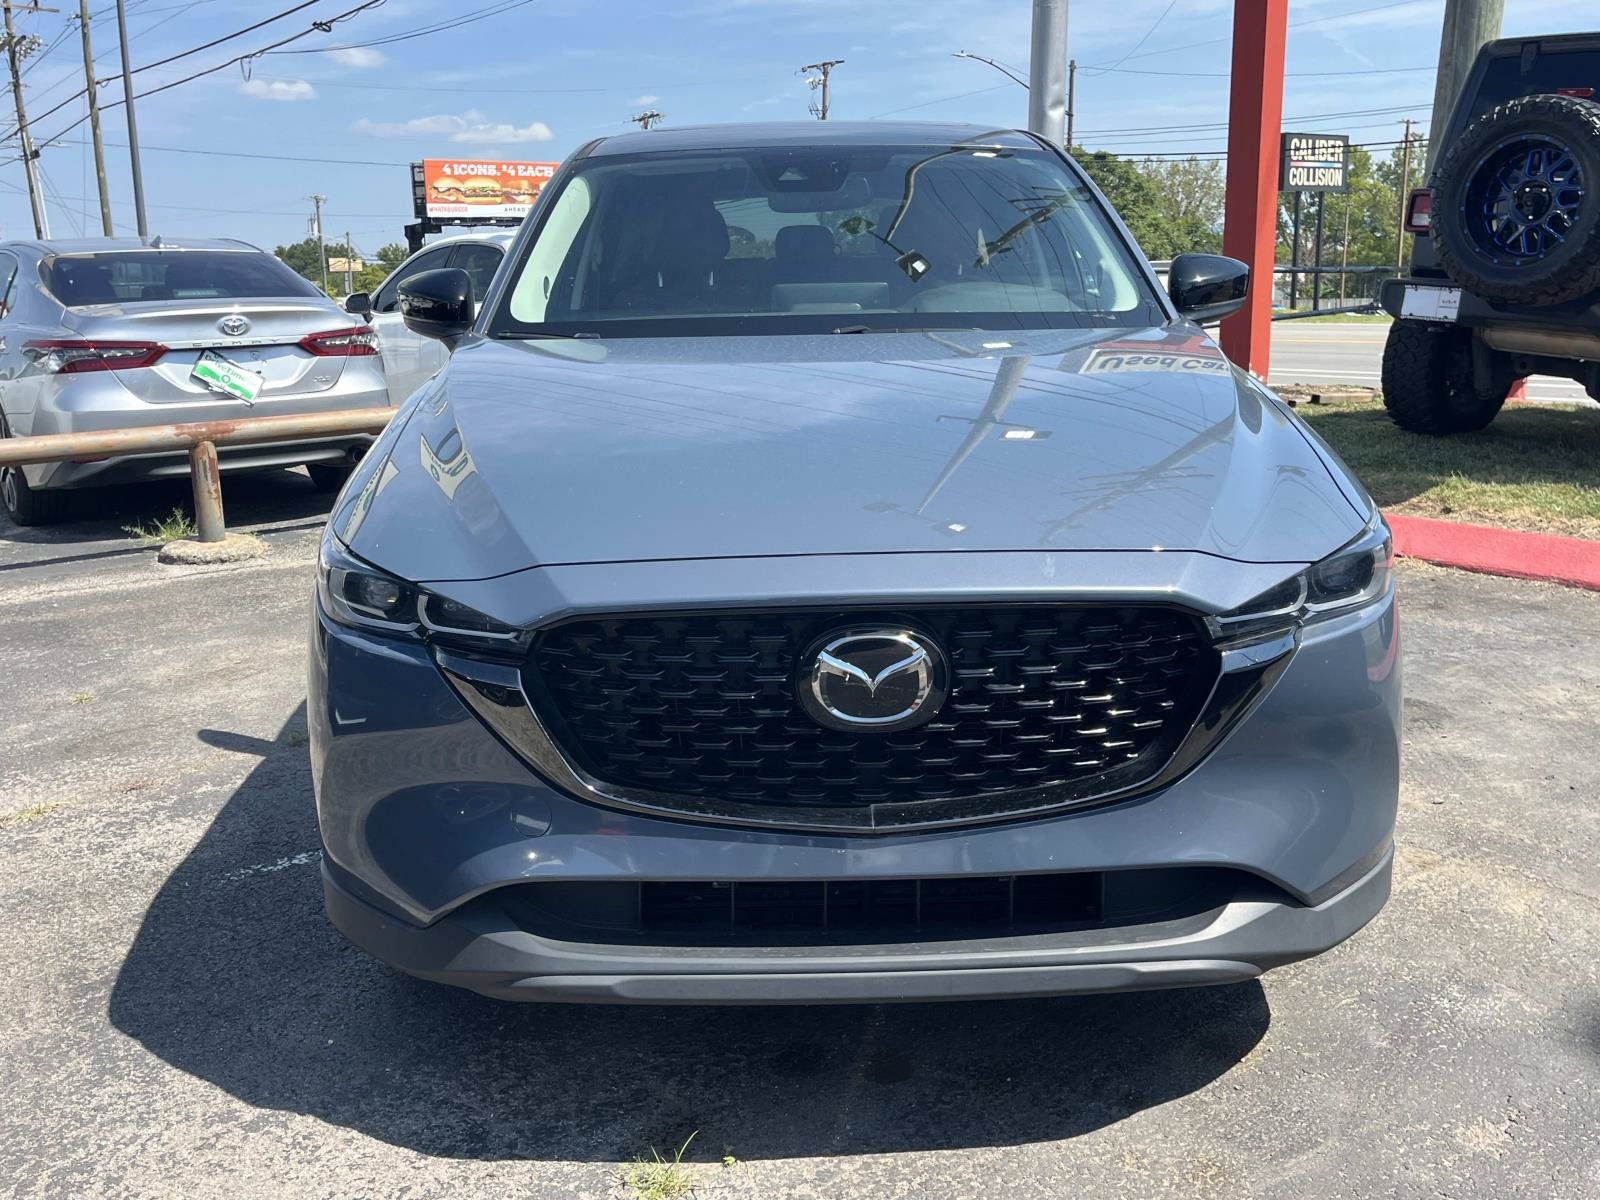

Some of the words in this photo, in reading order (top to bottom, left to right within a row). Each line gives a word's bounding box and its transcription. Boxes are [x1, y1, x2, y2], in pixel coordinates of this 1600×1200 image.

[1290, 138, 1344, 162] CALIBER
[442, 164, 451, 176] 4
[453, 164, 501, 177] ICONS.
[502, 164, 516, 177] $4
[517, 165, 554, 178] EACH
[1289, 167, 1343, 187] COLLISION
